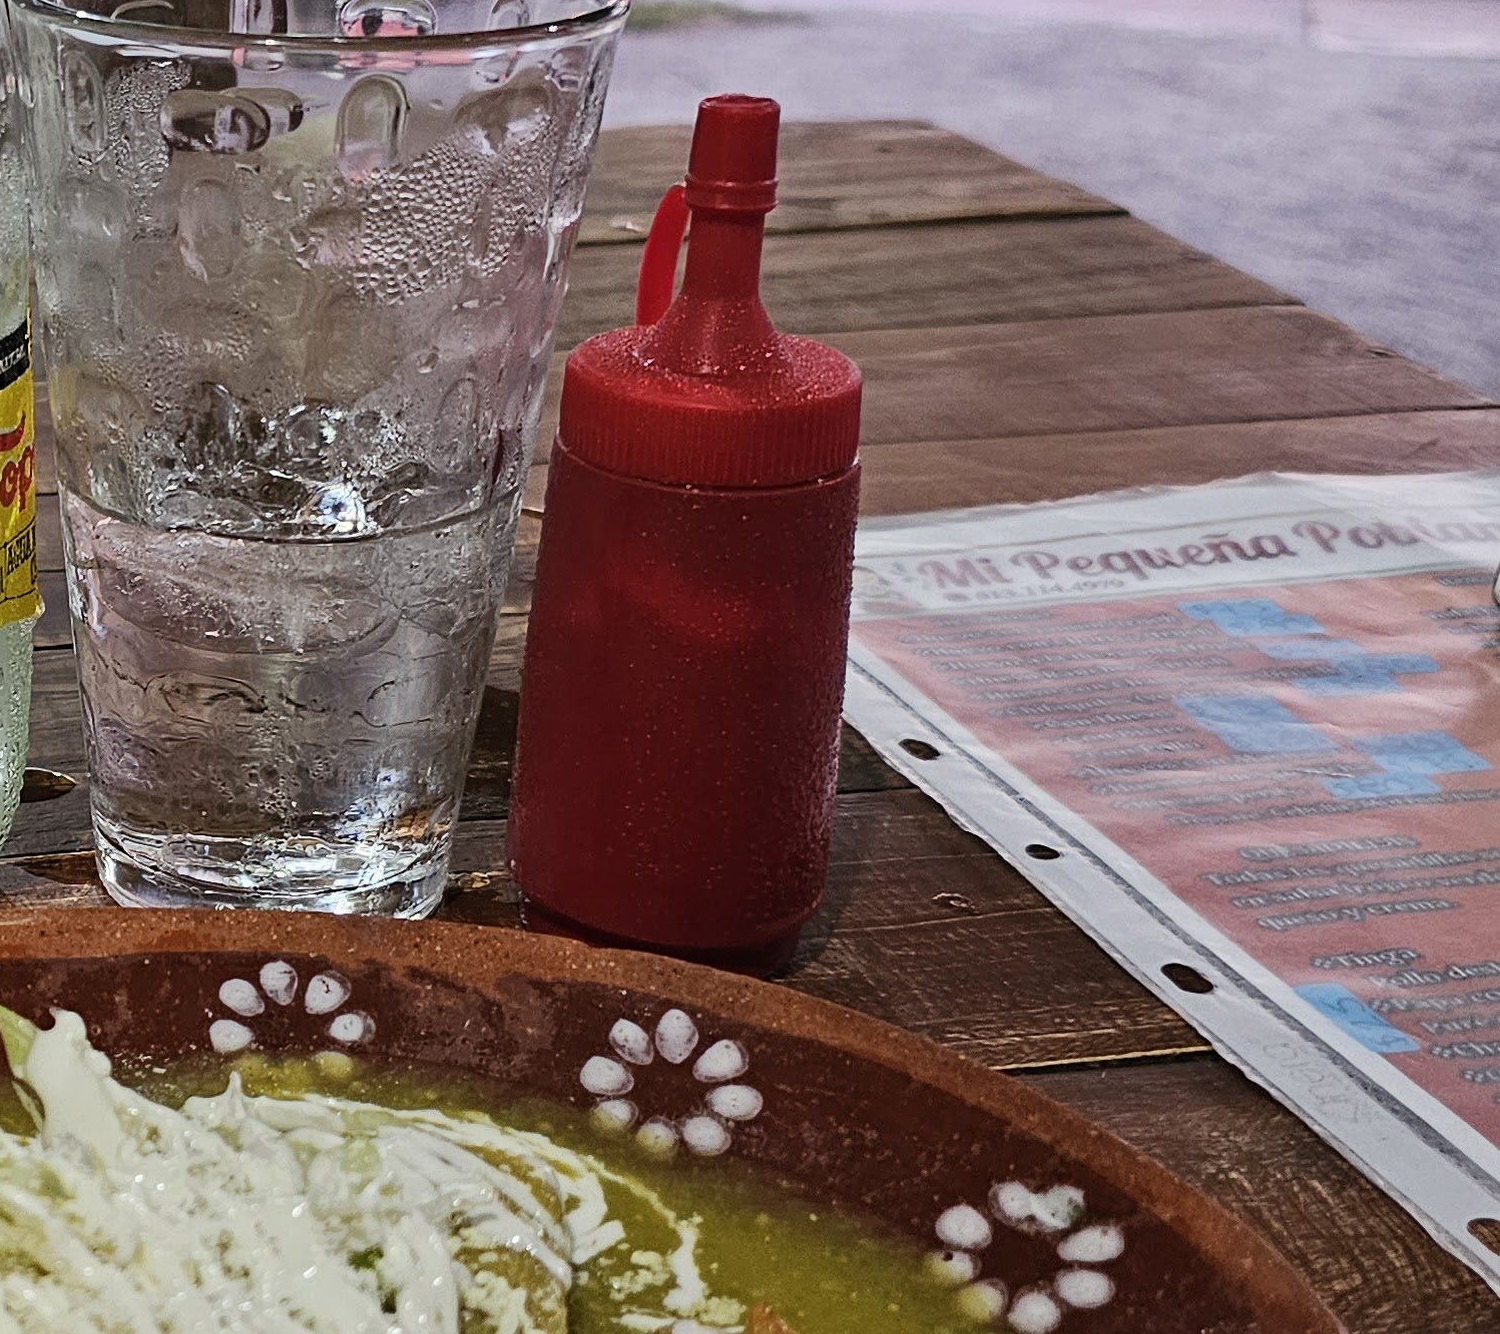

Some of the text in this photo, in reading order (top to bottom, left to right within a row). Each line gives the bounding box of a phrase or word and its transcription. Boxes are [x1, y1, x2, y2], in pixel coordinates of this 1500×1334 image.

[917, 558, 1013, 588] Mi
[1009, 533, 1298, 581] Pequeña
[1331, 948, 1418, 966] Tinga
